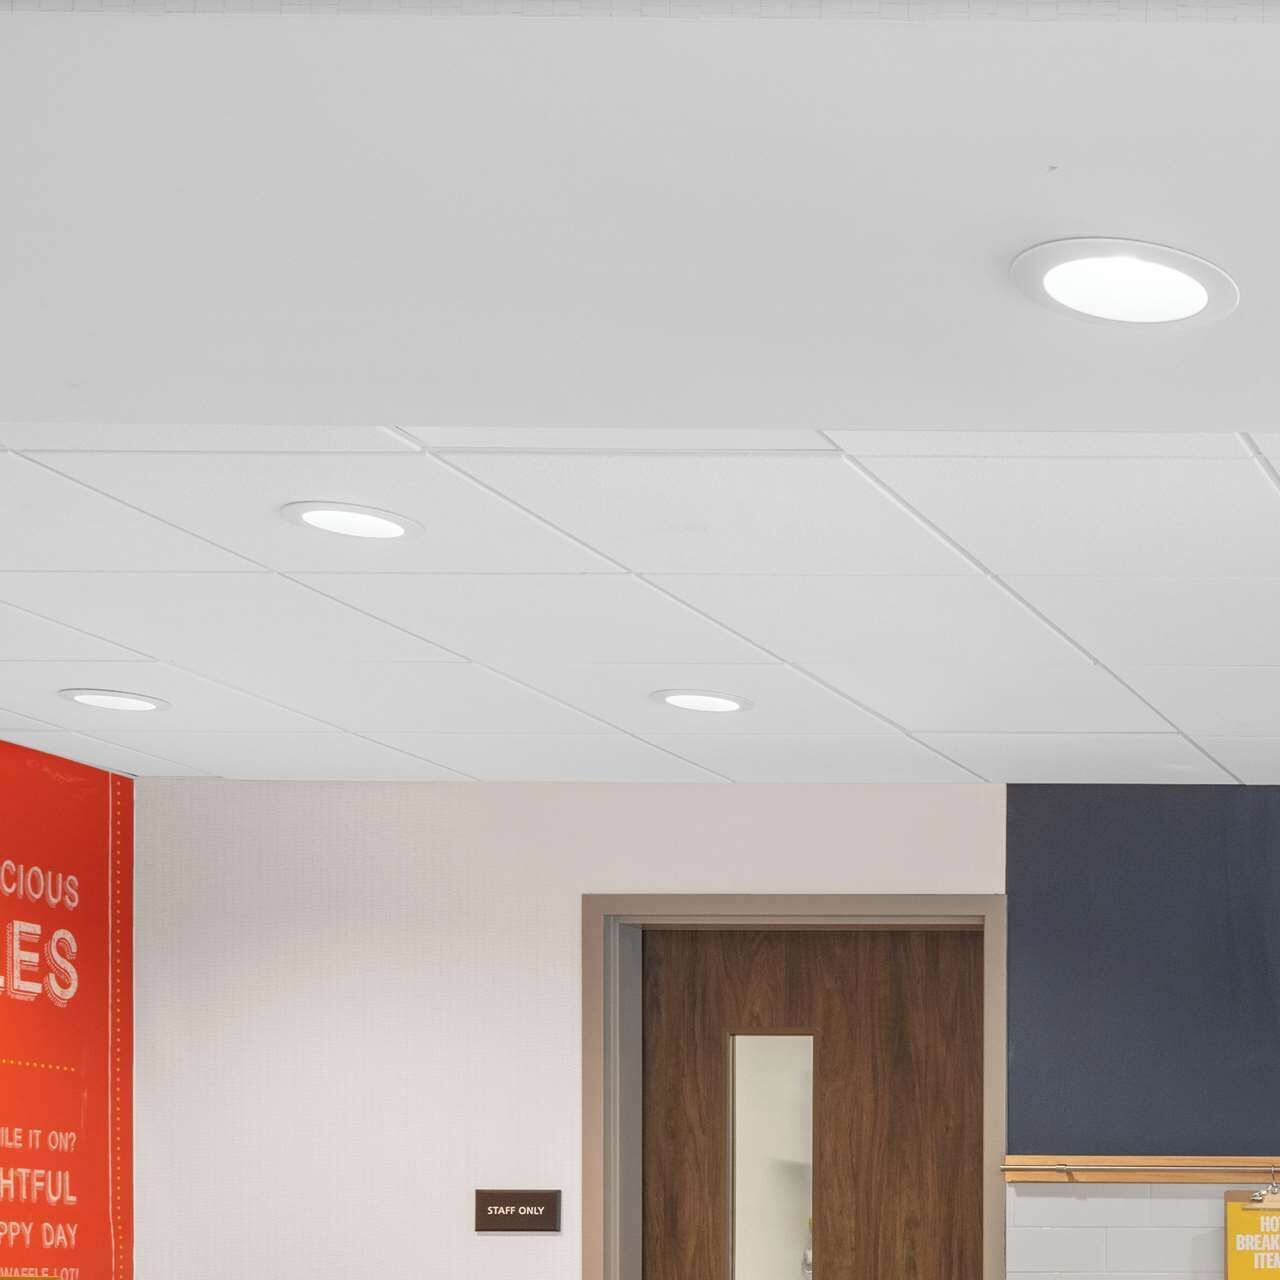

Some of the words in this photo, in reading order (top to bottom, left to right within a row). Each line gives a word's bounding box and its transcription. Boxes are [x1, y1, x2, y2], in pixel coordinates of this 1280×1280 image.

[0, 859, 79, 909] CIOUS
[0, 919, 79, 1006] ES
[29, 1129, 42, 1150] IT
[48, 1130, 77, 1152] ON?
[0, 1167, 77, 1205] HTFUL
[487, 1206, 516, 1215] STAFF
[518, 1206, 545, 1215] ONLY
[42, 1222, 78, 1249] DAY
